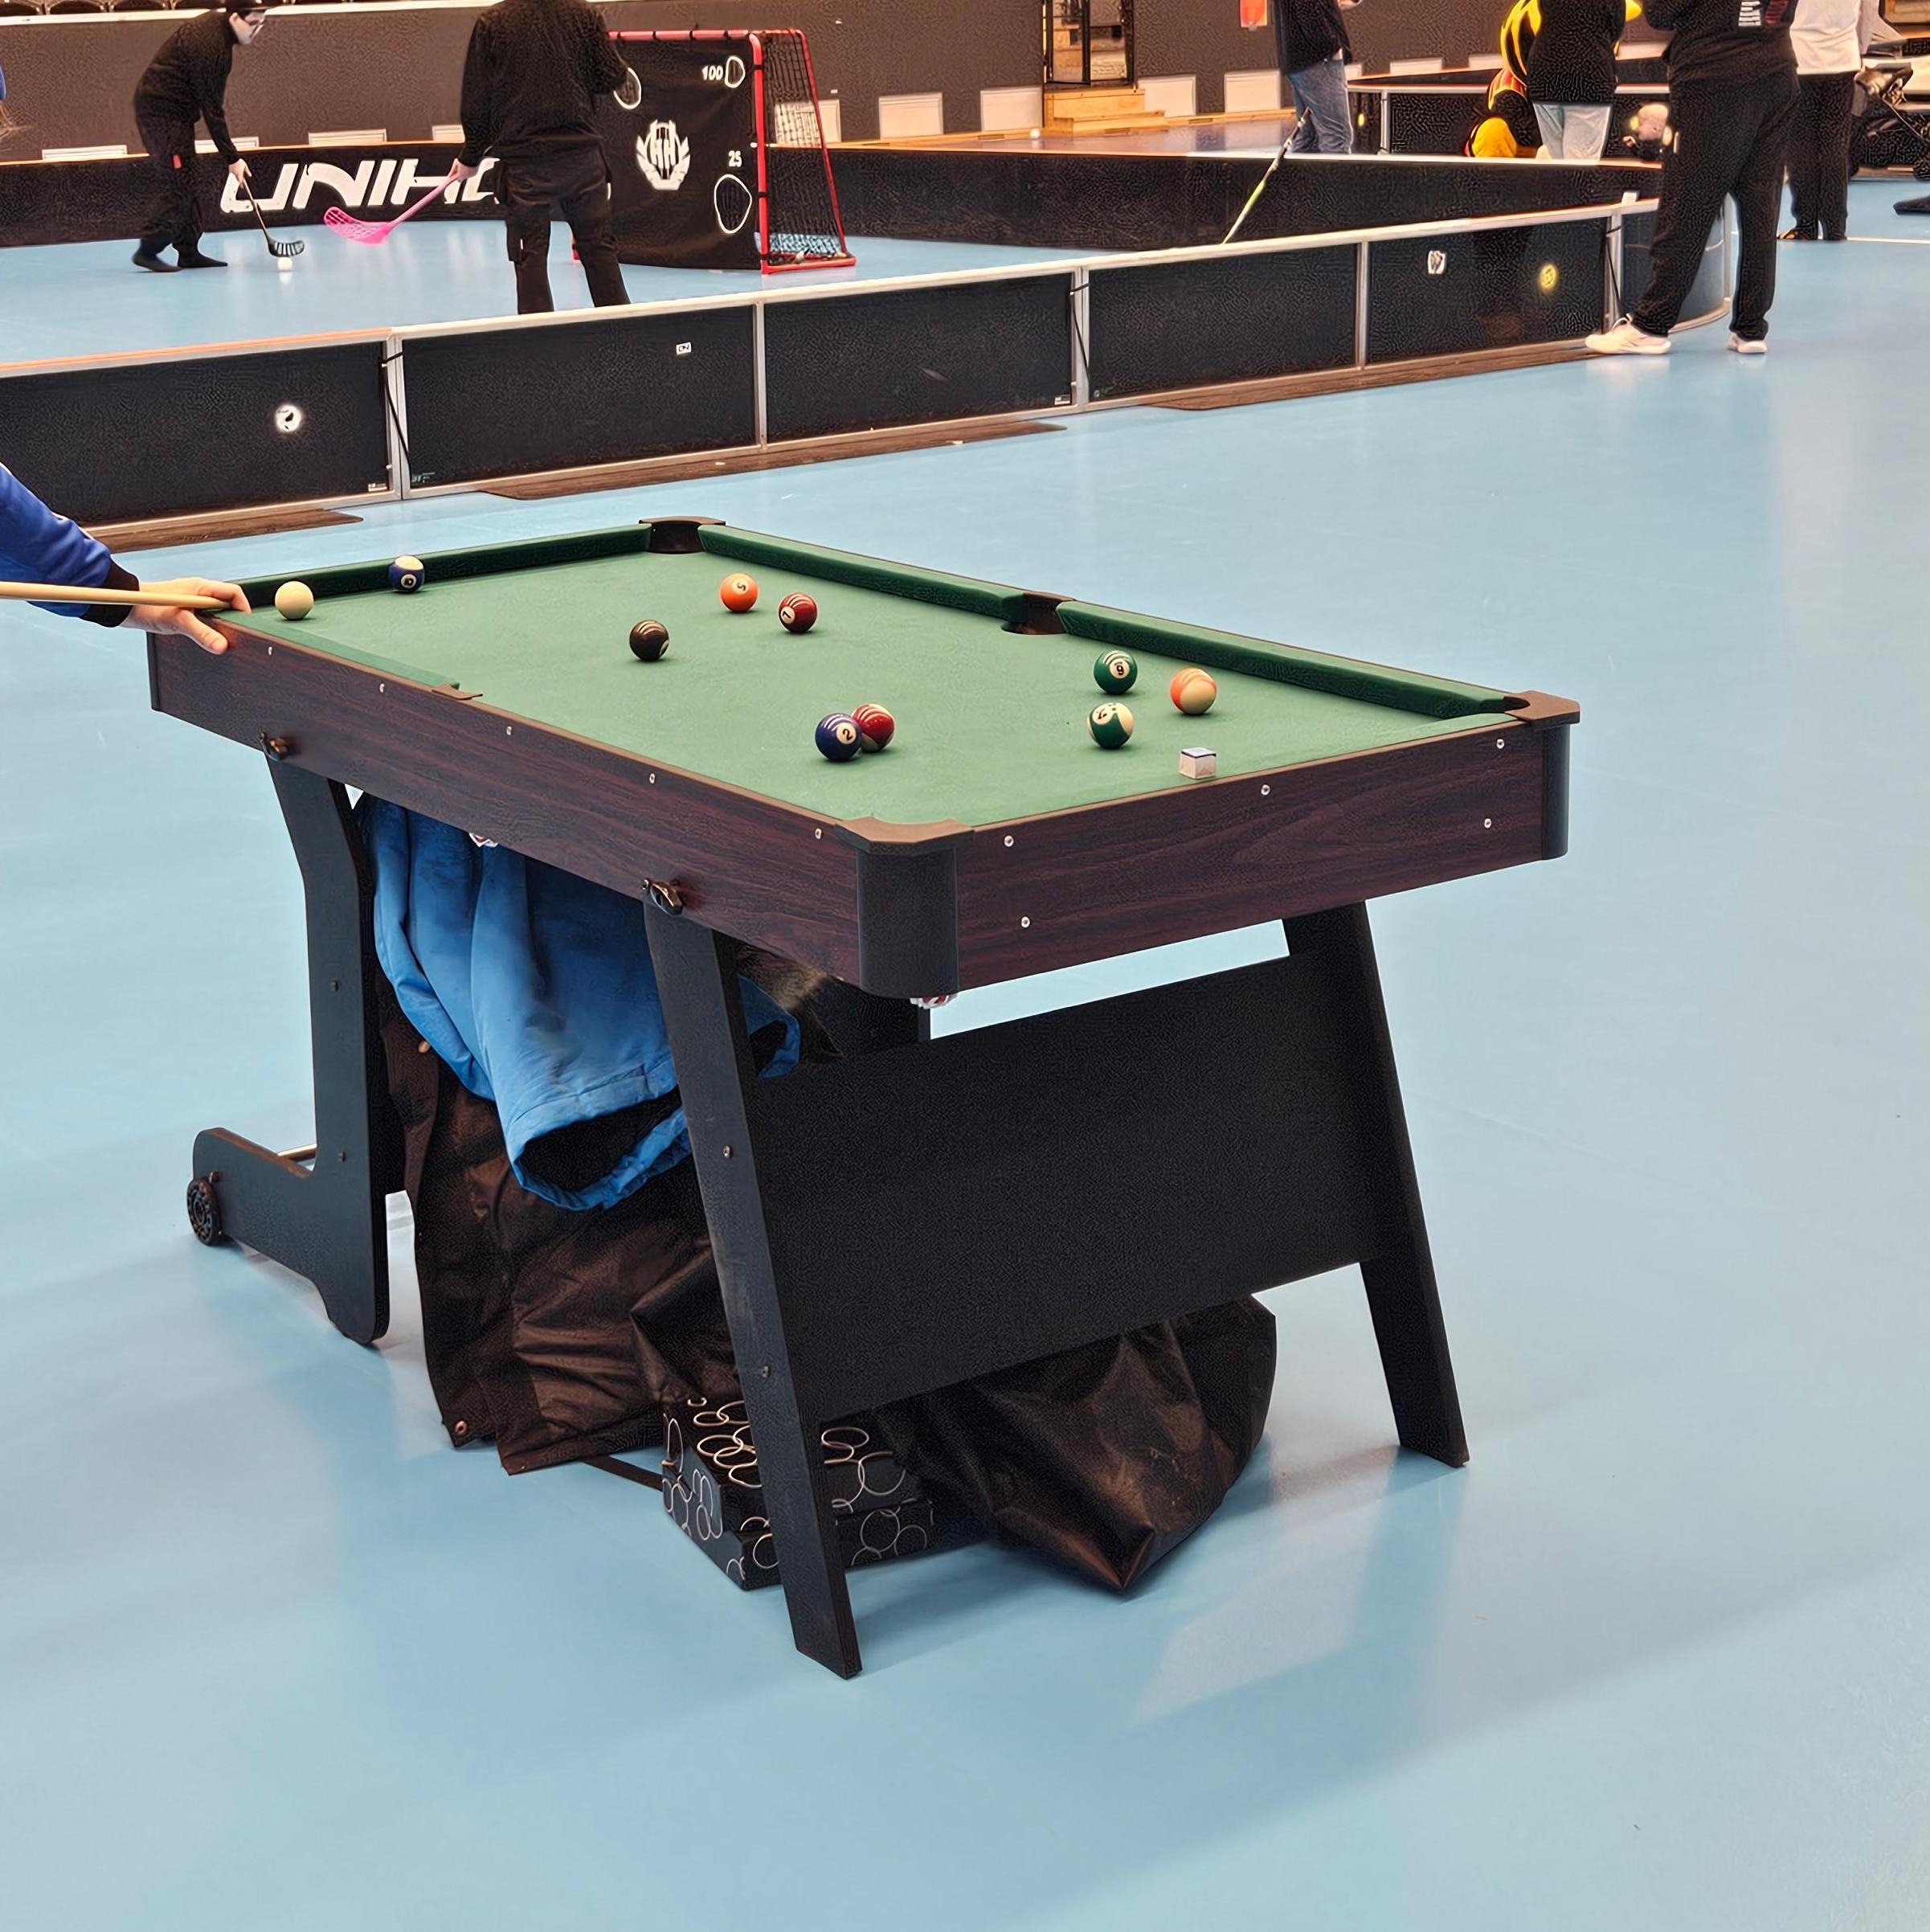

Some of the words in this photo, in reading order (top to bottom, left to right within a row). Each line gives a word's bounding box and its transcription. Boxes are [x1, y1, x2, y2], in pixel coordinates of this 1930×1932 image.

[701, 65, 724, 80] 100
[728, 150, 742, 167] 25
[842, 728, 853, 741] 2
